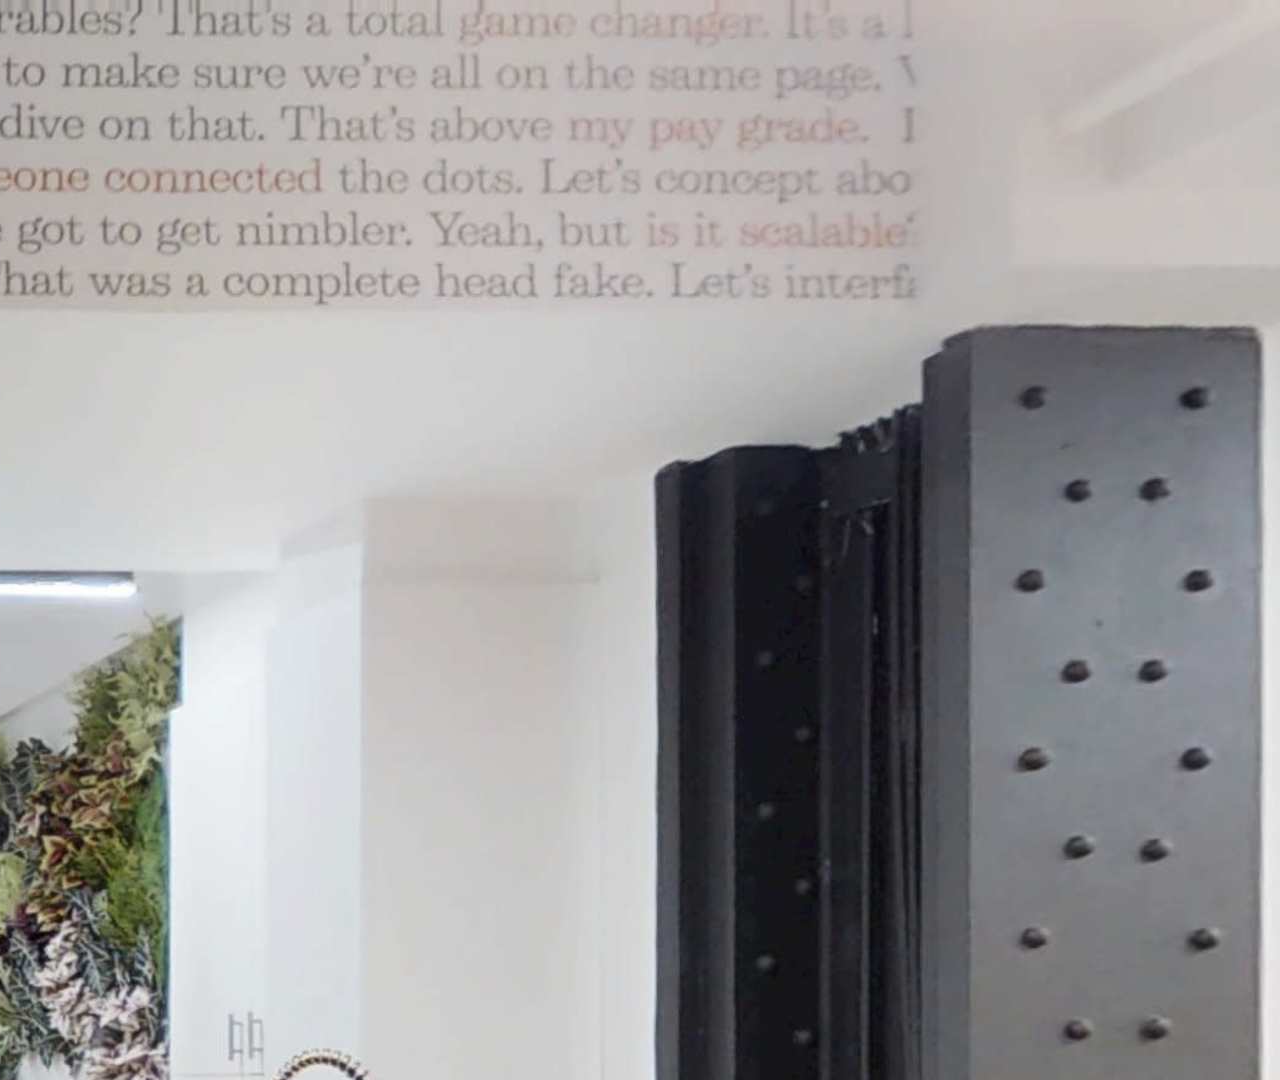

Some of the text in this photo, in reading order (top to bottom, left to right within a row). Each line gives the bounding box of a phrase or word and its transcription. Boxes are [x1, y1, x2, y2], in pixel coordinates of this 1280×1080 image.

[158, 0, 292, 37] That's
[346, 0, 444, 38] total
[4, 53, 46, 88] to
[63, 48, 180, 89] make
[193, 61, 286, 89] sure
[302, 49, 417, 90] we're
[431, 50, 481, 90] all
[495, 63, 549, 91] on
[564, 51, 635, 91] the
[649, 62, 761, 91] same
[775, 61, 881, 100] page.
[98, 113, 150, 141] on
[168, 101, 265, 141] that.
[280, 101, 416, 142] That's
[429, 102, 553, 142] above
[104, 154, 323, 194] connected
[338, 154, 409, 194] the
[422, 154, 523, 195] dots.
[541, 155, 641, 195] Let's
[655, 160, 821, 205] concept
[18, 210, 84, 256] got
[100, 211, 142, 246] to
[157, 211, 221, 256] get
[237, 206, 413, 247] nimbler.
[429, 207, 544, 254] Yeah,
[558, 208, 630, 248] but
[88, 270, 172, 298] was
[185, 270, 209, 298] a
[223, 258, 421, 309] complete
[435, 259, 538, 300] head
[554, 260, 654, 300] fake.
[671, 260, 771, 300] Let's
